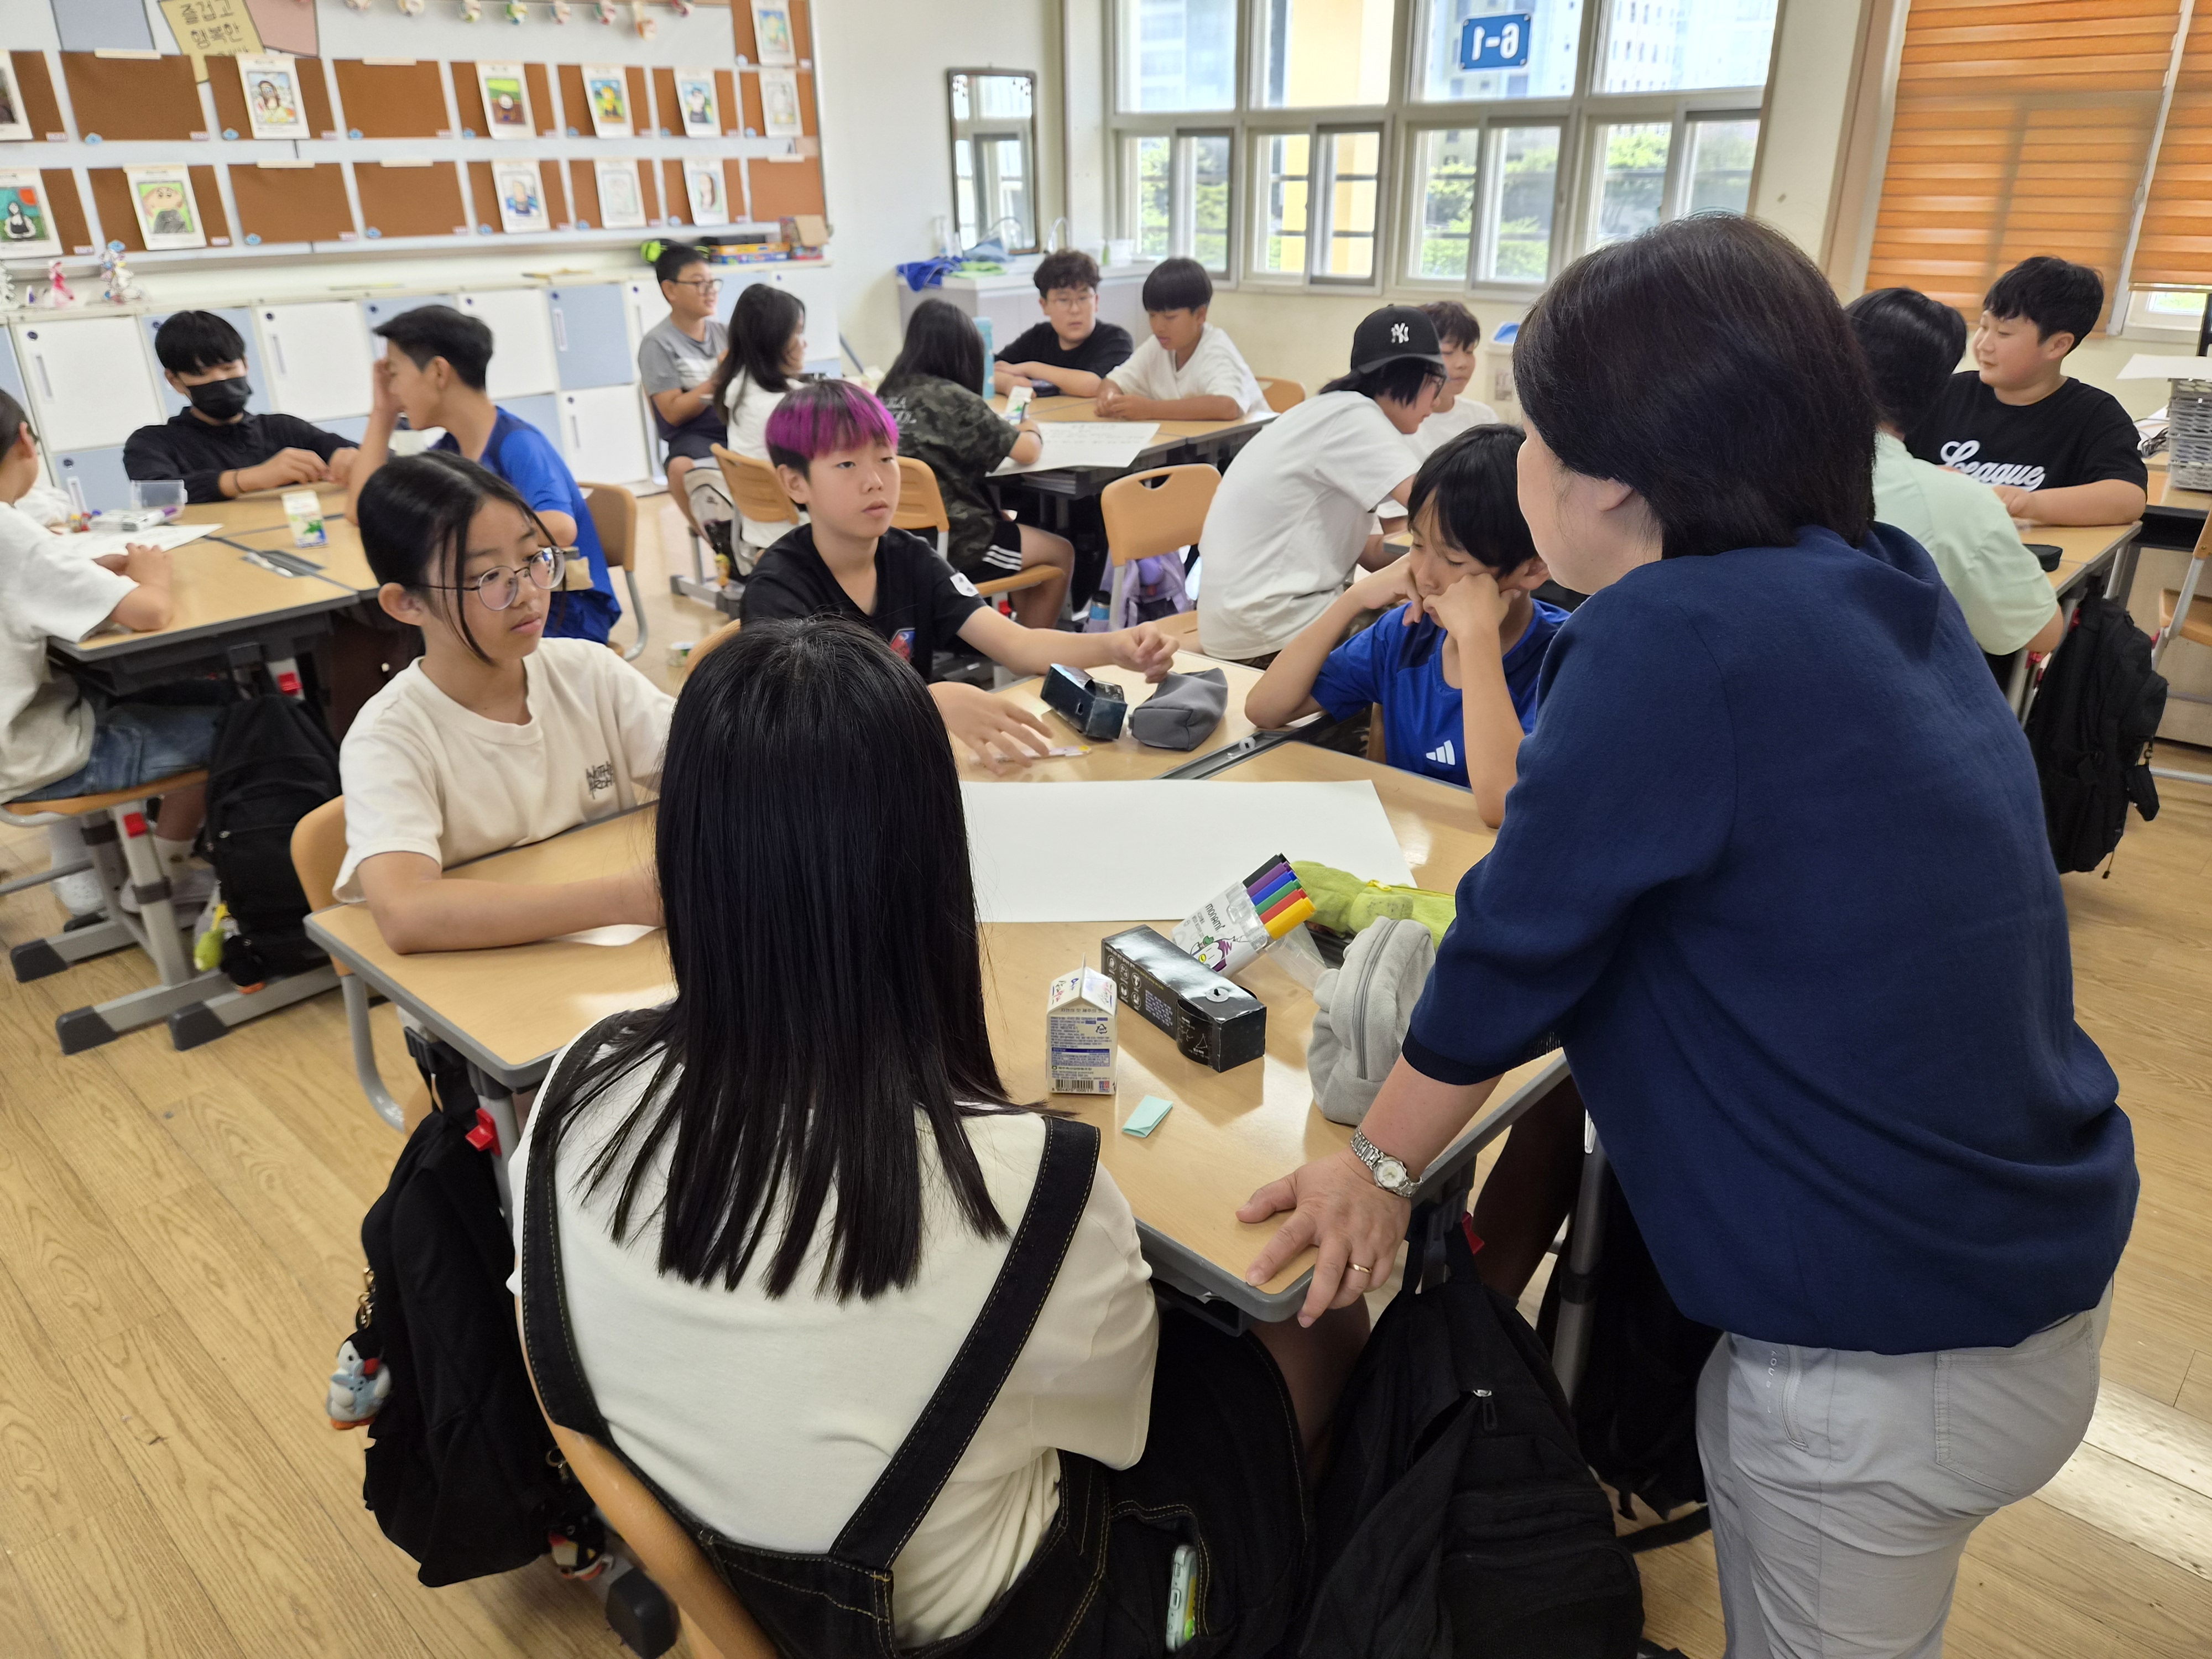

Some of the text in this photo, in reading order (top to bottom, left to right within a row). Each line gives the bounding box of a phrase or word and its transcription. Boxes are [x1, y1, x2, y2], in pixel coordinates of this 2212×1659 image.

[180, 0, 234, 25] 즐겁고
[191, 23, 243, 50] 행복한
[1391, 322, 1409, 343] NY
[1940, 440, 2046, 492] League
